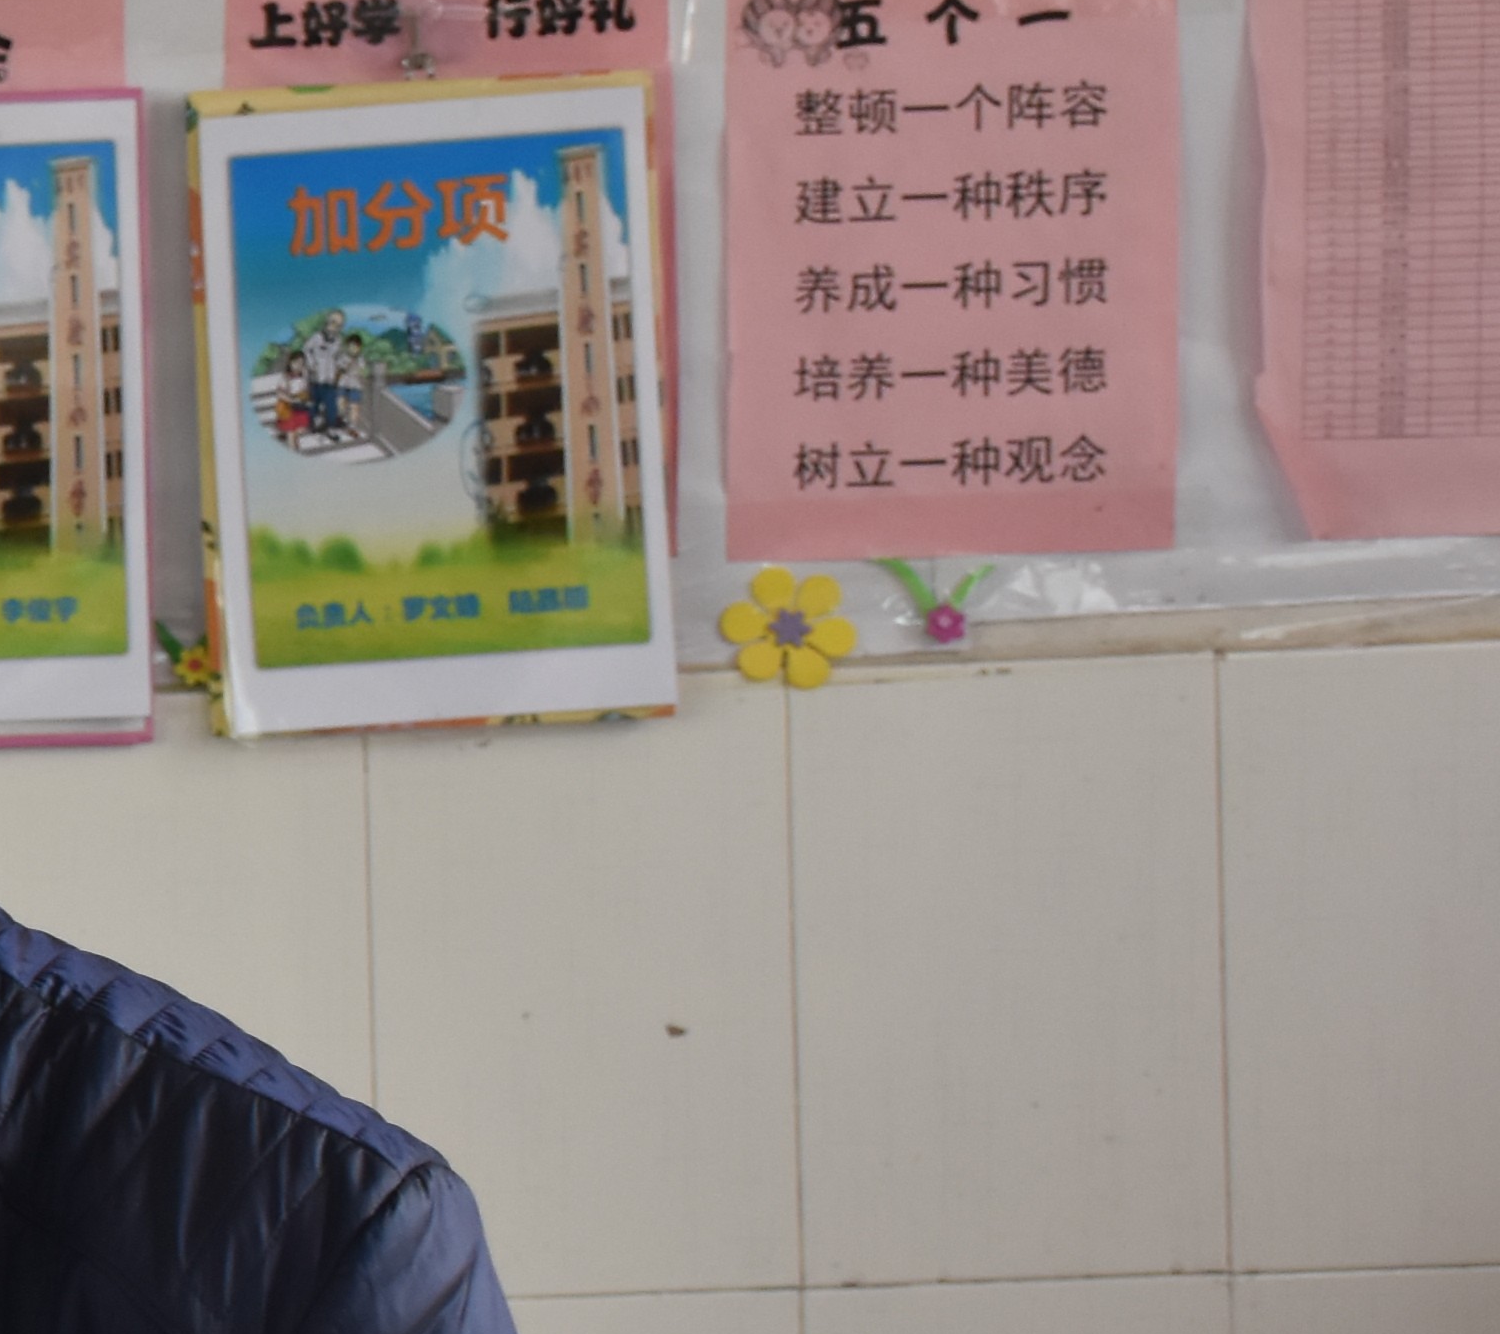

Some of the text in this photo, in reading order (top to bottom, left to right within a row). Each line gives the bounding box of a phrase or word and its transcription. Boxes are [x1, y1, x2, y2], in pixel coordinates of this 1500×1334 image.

[795, 80, 1108, 137] 整顿一个阵容
[286, 173, 510, 259] 加分项
[795, 168, 1108, 225] 建立一种秩序
[795, 257, 1109, 315] 养成一种习惯
[792, 346, 1107, 403] 培养一种美德
[792, 434, 1107, 492] 树立一种观念
